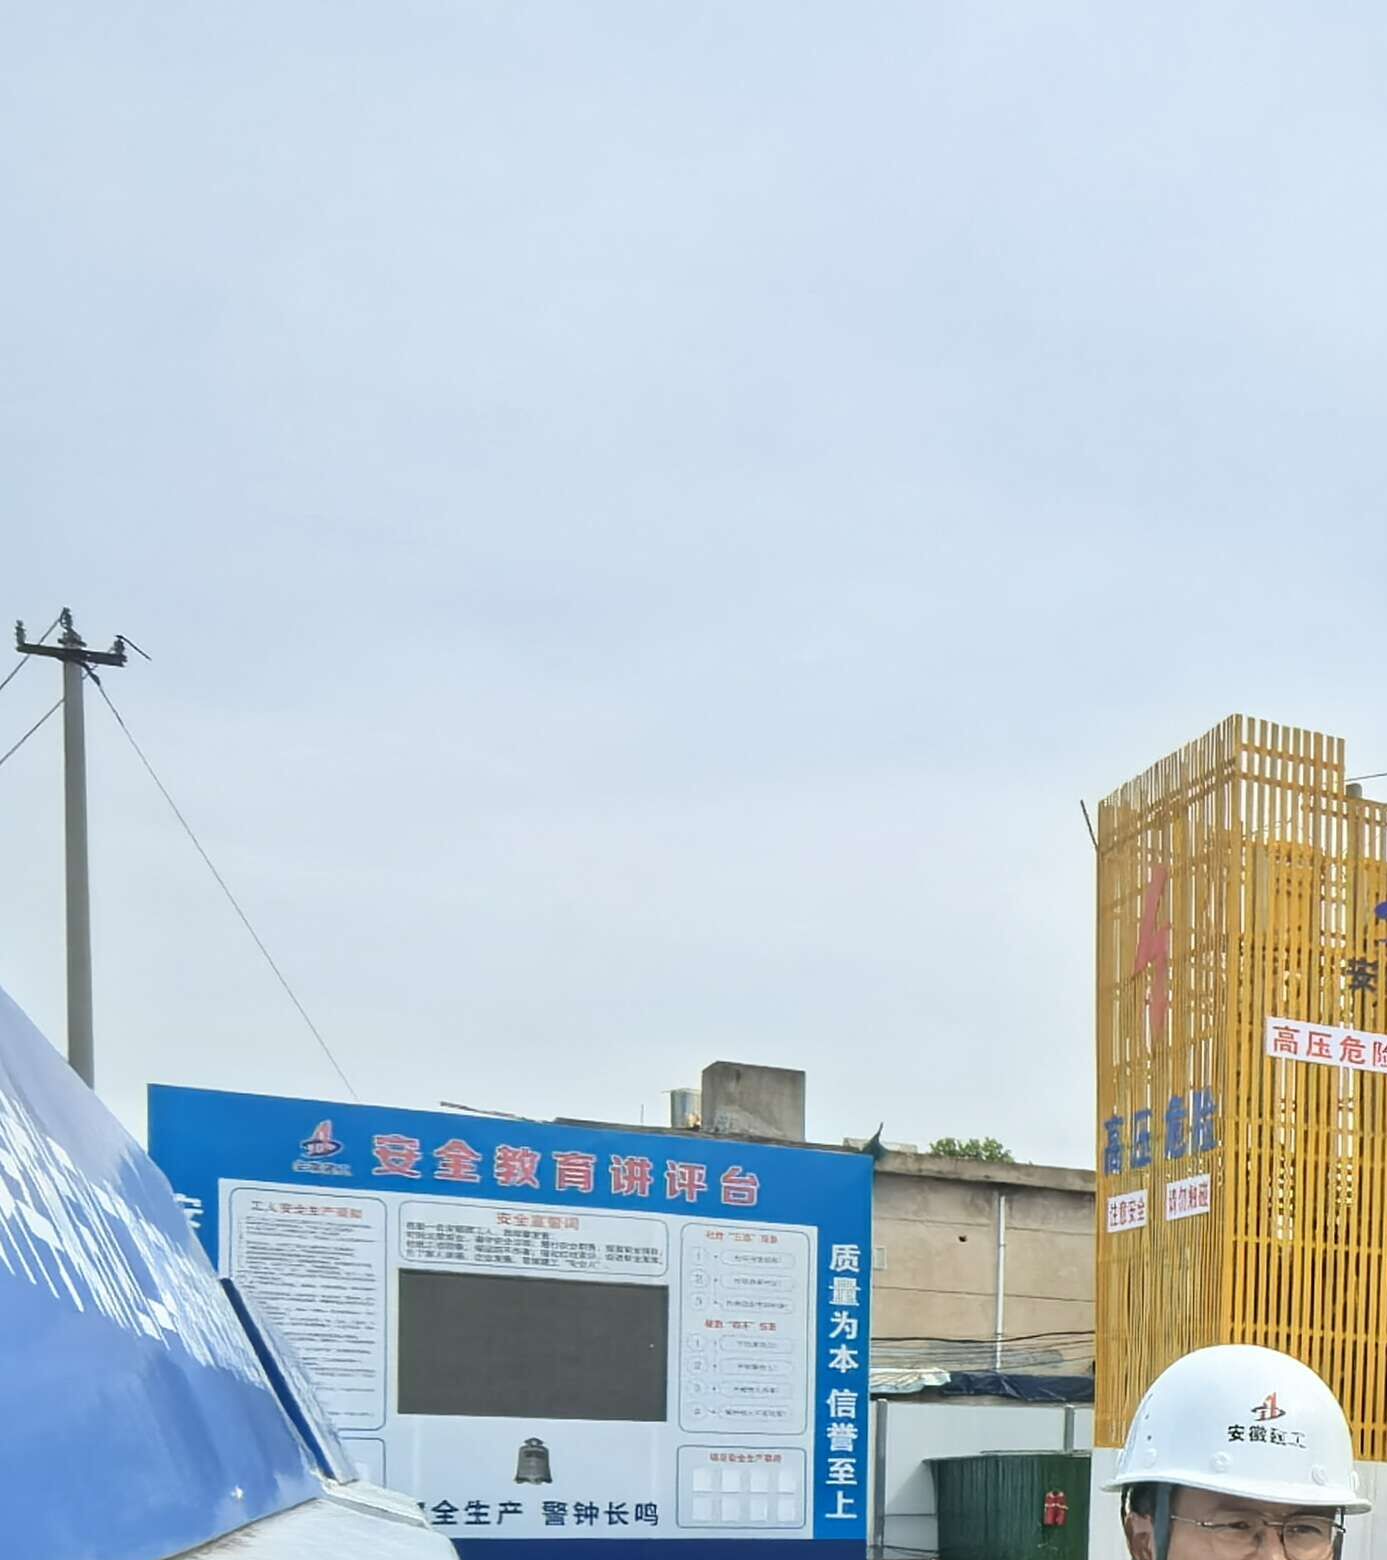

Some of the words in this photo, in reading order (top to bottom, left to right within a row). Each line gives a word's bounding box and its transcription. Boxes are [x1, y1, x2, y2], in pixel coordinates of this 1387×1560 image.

[371, 1133, 760, 1206] 安全教育讲评台
[828, 1244, 861, 1374] 质量为本
[825, 1389, 858, 1519] 信誉至上
[1227, 1424, 1307, 1449] 安徽建工
[417, 1499, 523, 1526] 全生产
[541, 1500, 659, 1527] 警钟长鸣
